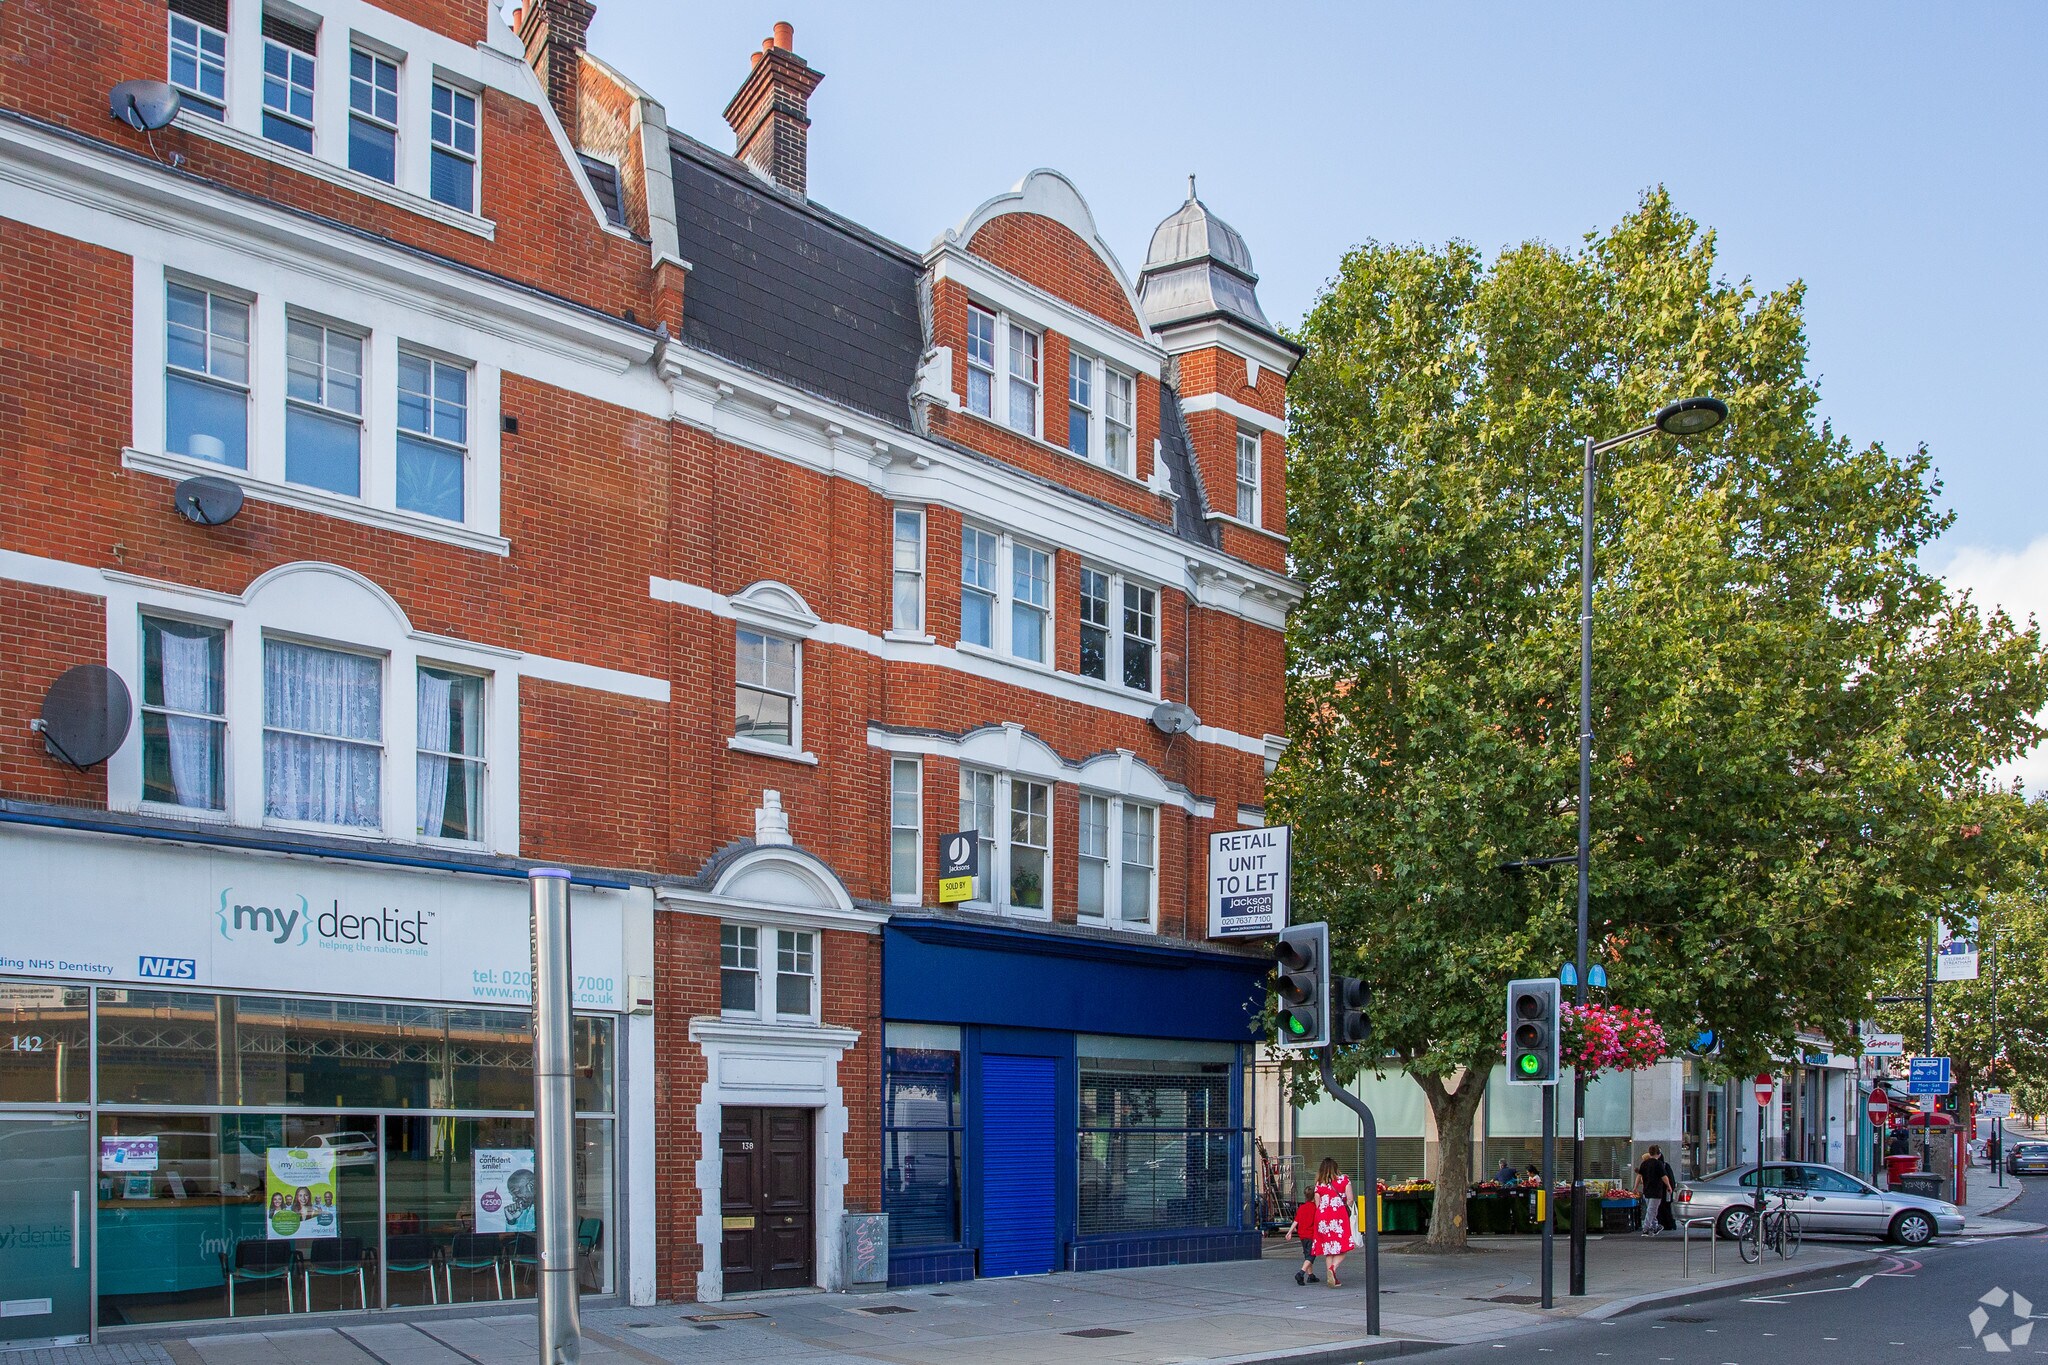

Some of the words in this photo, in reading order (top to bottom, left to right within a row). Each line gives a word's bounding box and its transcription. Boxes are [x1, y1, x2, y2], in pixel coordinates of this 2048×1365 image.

[1219, 832, 1276, 852] RETAIL
[1229, 855, 1267, 872] UNIT
[945, 882, 958, 890] SOLD
[959, 881, 966, 889] BY
[1217, 876, 1240, 894] TO
[1246, 872, 1279, 892] LET
[1230, 896, 1272, 909] jackson
[1246, 904, 1272, 914] criss
[317, 899, 429, 945] dentist
[1221, 918, 1235, 926] 020
[1254, 915, 1271, 923] 7100
[318, 939, 354, 953] helping
[356, 942, 372, 952] the
[373, 944, 403, 954] nation
[404, 947, 429, 957] smile
[28, 959, 55, 970] NHS
[58, 961, 114, 975] Dentistry
[140, 958, 193, 978] NHS
[472, 969, 498, 984] tel:
[577, 976, 614, 992] 7000
[10, 1035, 43, 1052] 142
[741, 1142, 754, 1150] 138
[20, 1225, 74, 1243] dentis
